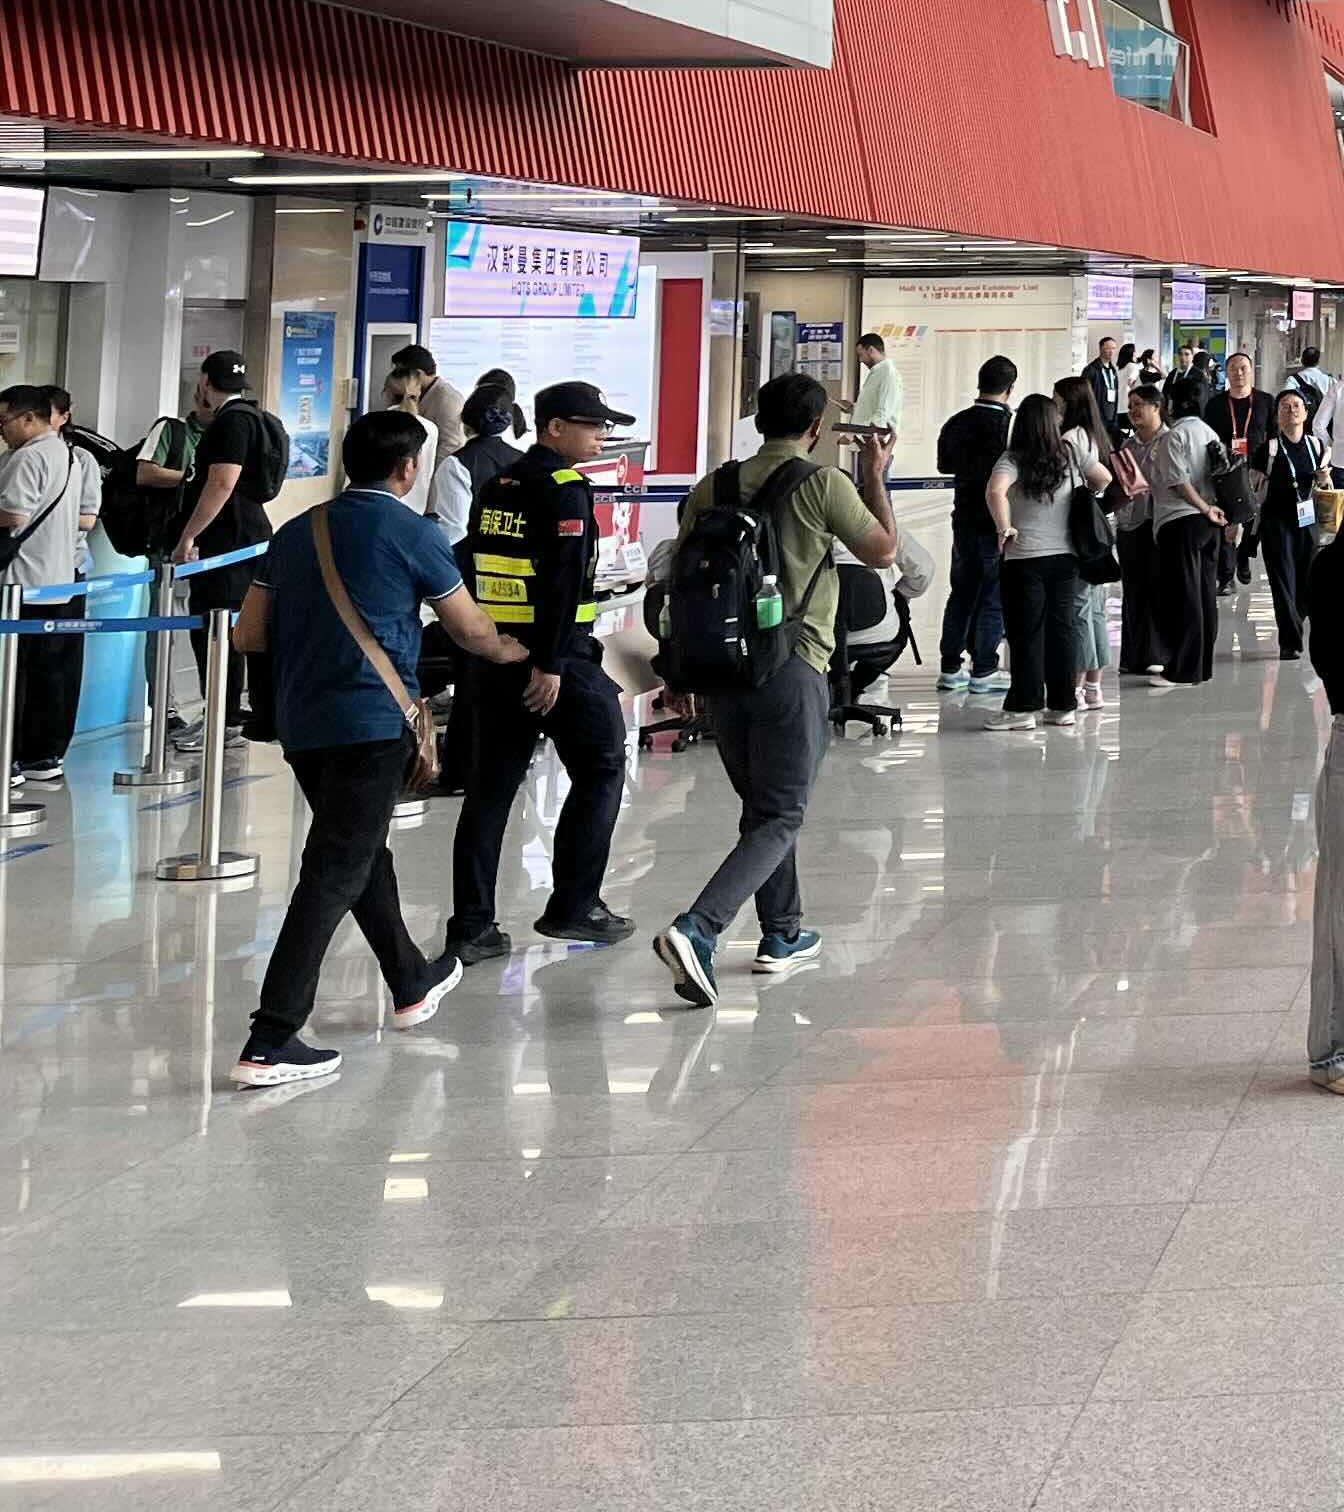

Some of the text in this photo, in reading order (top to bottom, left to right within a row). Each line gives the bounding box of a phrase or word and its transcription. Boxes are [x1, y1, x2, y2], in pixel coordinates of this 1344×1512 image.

[487, 243, 609, 278] 汉斯曼集团有限公司
